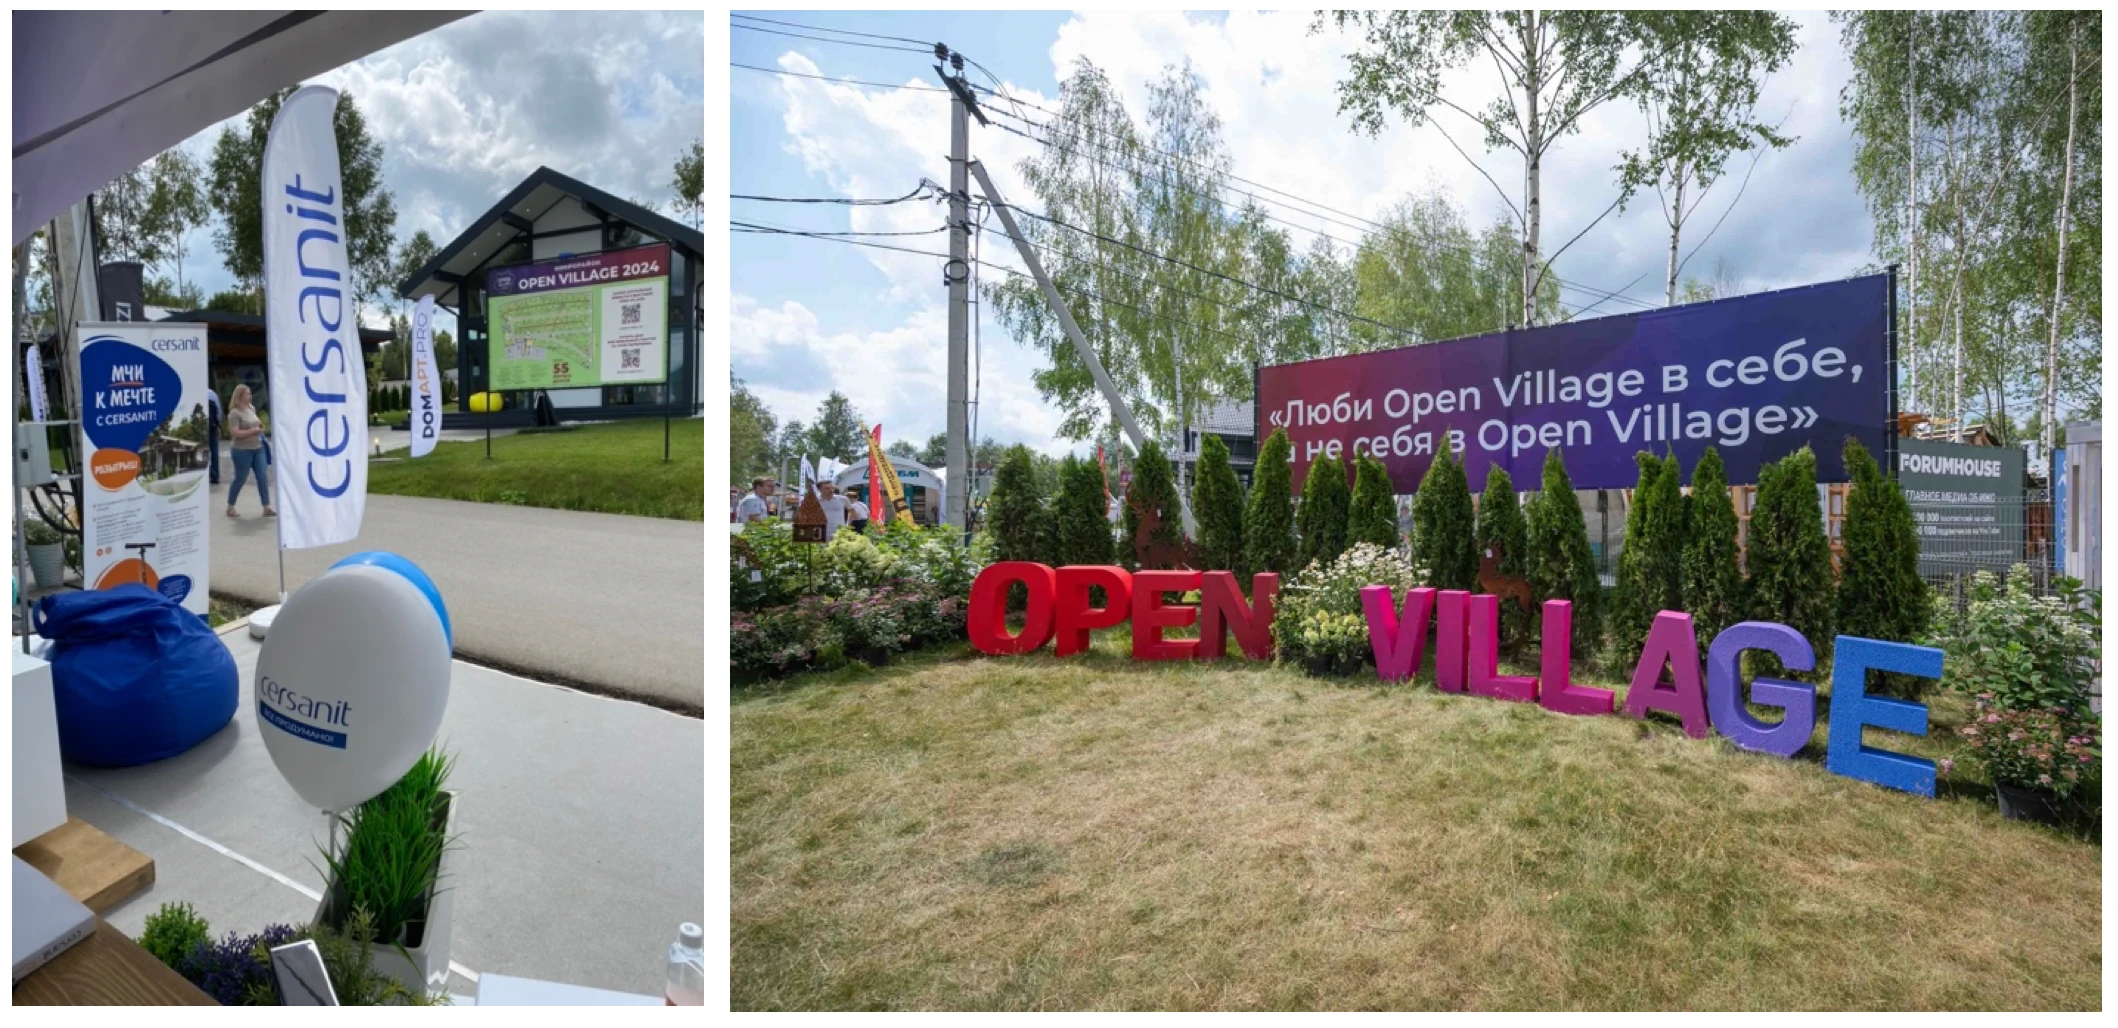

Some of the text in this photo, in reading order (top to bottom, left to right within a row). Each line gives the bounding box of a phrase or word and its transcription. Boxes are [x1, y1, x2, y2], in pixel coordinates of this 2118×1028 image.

[518, 274, 556, 290] OPEN
[559, 265, 619, 285] VILLAGE
[622, 260, 660, 276] 2024
[152, 336, 200, 351] cersanit
[285, 173, 351, 499] cersanit
[111, 364, 144, 382] МЧИ
[553, 362, 569, 375] 55
[1269, 337, 1863, 427] «Люби Open Village в себе,
[95, 387, 156, 409] К МЕЧТЕ
[96, 410, 157, 426] С CERSANIT!
[1306, 437, 1344, 463] не
[1352, 424, 1432, 458] себя
[1478, 418, 1592, 457] Open
[1607, 402, 1819, 447] Village»
[1900, 453, 2002, 478] FORUMHOUSE
[1905, 490, 1941, 502] ГЛАВНОЕ
[967, 560, 1279, 661] OPEN
[260, 675, 353, 727] cersanit
[1360, 584, 1944, 798] VILLAGE
